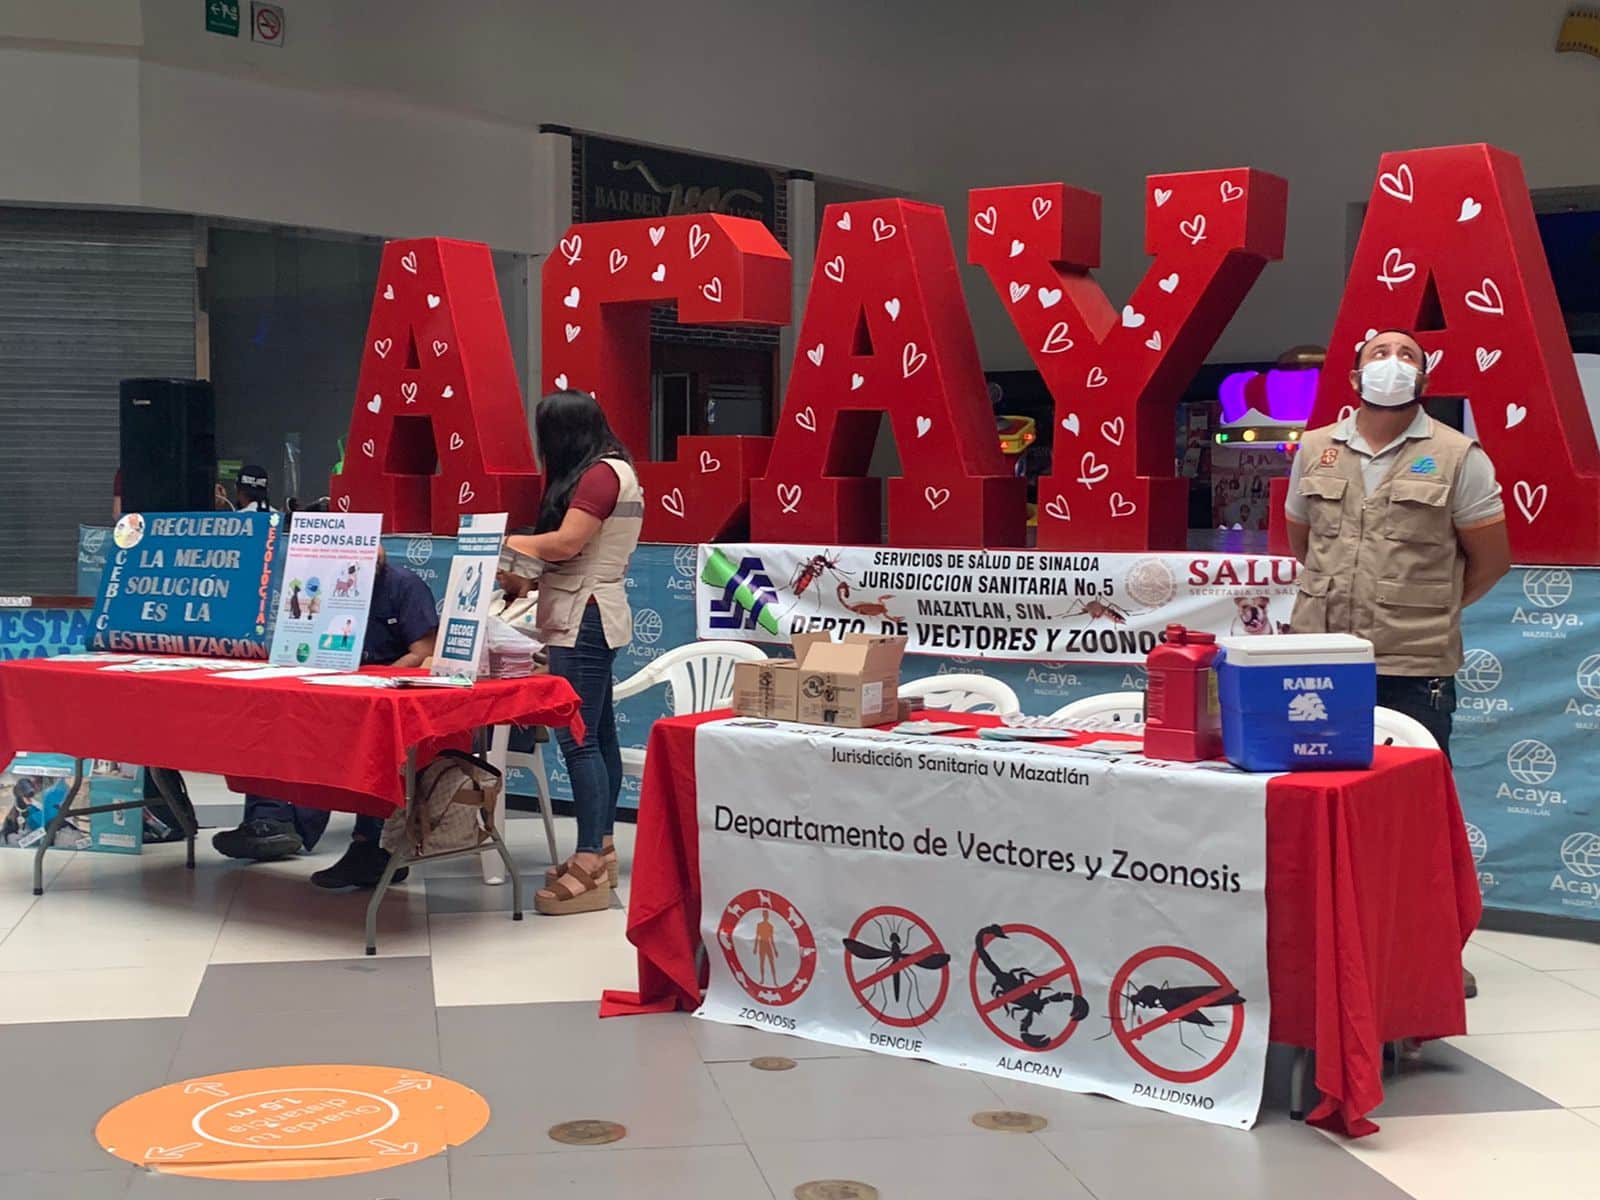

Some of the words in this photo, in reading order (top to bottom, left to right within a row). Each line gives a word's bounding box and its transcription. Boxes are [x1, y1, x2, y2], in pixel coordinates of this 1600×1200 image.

[151, 517, 254, 537] RECUERDA
[294, 518, 345, 529] TENENCIA
[291, 534, 377, 547] RESPONSABLE
[139, 550, 164, 568] LA
[174, 549, 240, 568] MEJOR
[873, 551, 943, 569] SERVICIOS
[947, 553, 965, 569] DE
[968, 554, 1011, 570] SALUD
[1016, 556, 1034, 571] DE
[1039, 556, 1099, 572] SINALOA
[859, 571, 973, 593] JURISDICCION
[978, 574, 1068, 596] SANITARIA
[1074, 577, 1114, 597] No.5
[1188, 559, 1297, 586] SALU
[125, 573, 230, 598] SOLUCIÓN
[141, 601, 168, 621] ES
[184, 602, 211, 622] LA
[1016, 603, 1052, 620] SIN.
[1511, 606, 1584, 629] Acaya.
[109, 630, 268, 660] ESTERILIZACIÓN
[916, 622, 1038, 652] VECTORES
[1046, 629, 1061, 652] Y
[1025, 668, 1081, 686] Acaya.
[1283, 677, 1334, 690] RABIA
[1293, 743, 1333, 755] MZT.
[831, 746, 914, 770] Jurisdicción
[918, 753, 989, 777] Sanitaria
[993, 759, 1005, 777] V
[1010, 764, 1090, 787] Mazatlán
[1496, 782, 1567, 807] Acaya.
[714, 804, 905, 852] Departamento
[913, 827, 948, 857] de
[956, 831, 1075, 873] Vectores
[1084, 855, 1102, 880] y
[1111, 850, 1242, 893] Zoonosis
[737, 1007, 797, 1031] ZOONOSIS
[869, 1033, 923, 1054] DENGUE
[996, 1056, 1063, 1080] ALACRAN
[1132, 1082, 1215, 1111] PALUDISMO
